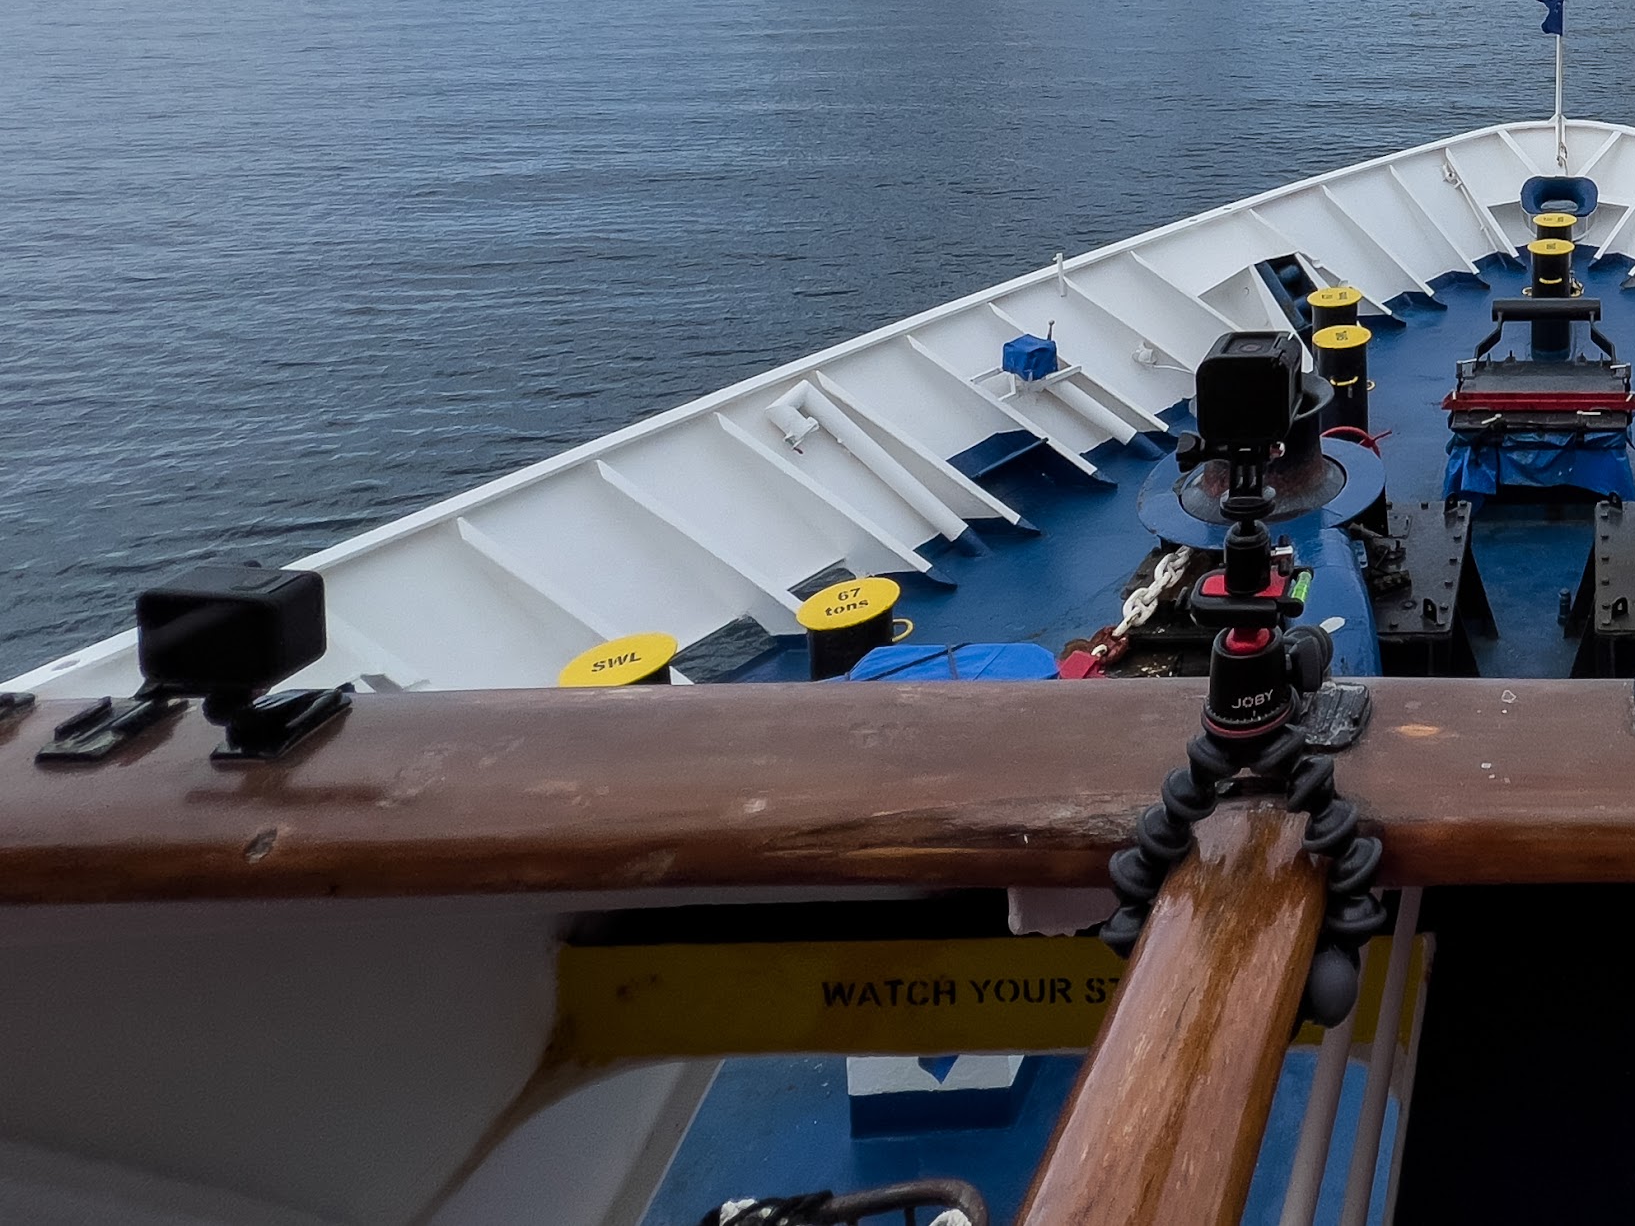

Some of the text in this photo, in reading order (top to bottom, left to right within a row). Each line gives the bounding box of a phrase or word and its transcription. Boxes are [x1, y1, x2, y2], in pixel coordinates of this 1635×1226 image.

[837, 587, 861, 601] 67
[825, 599, 869, 616] tons
[591, 652, 642, 672] SWL
[1231, 688, 1274, 709] JOBY
[821, 978, 957, 1007] WATCH
[968, 977, 1073, 1004] YOUR
